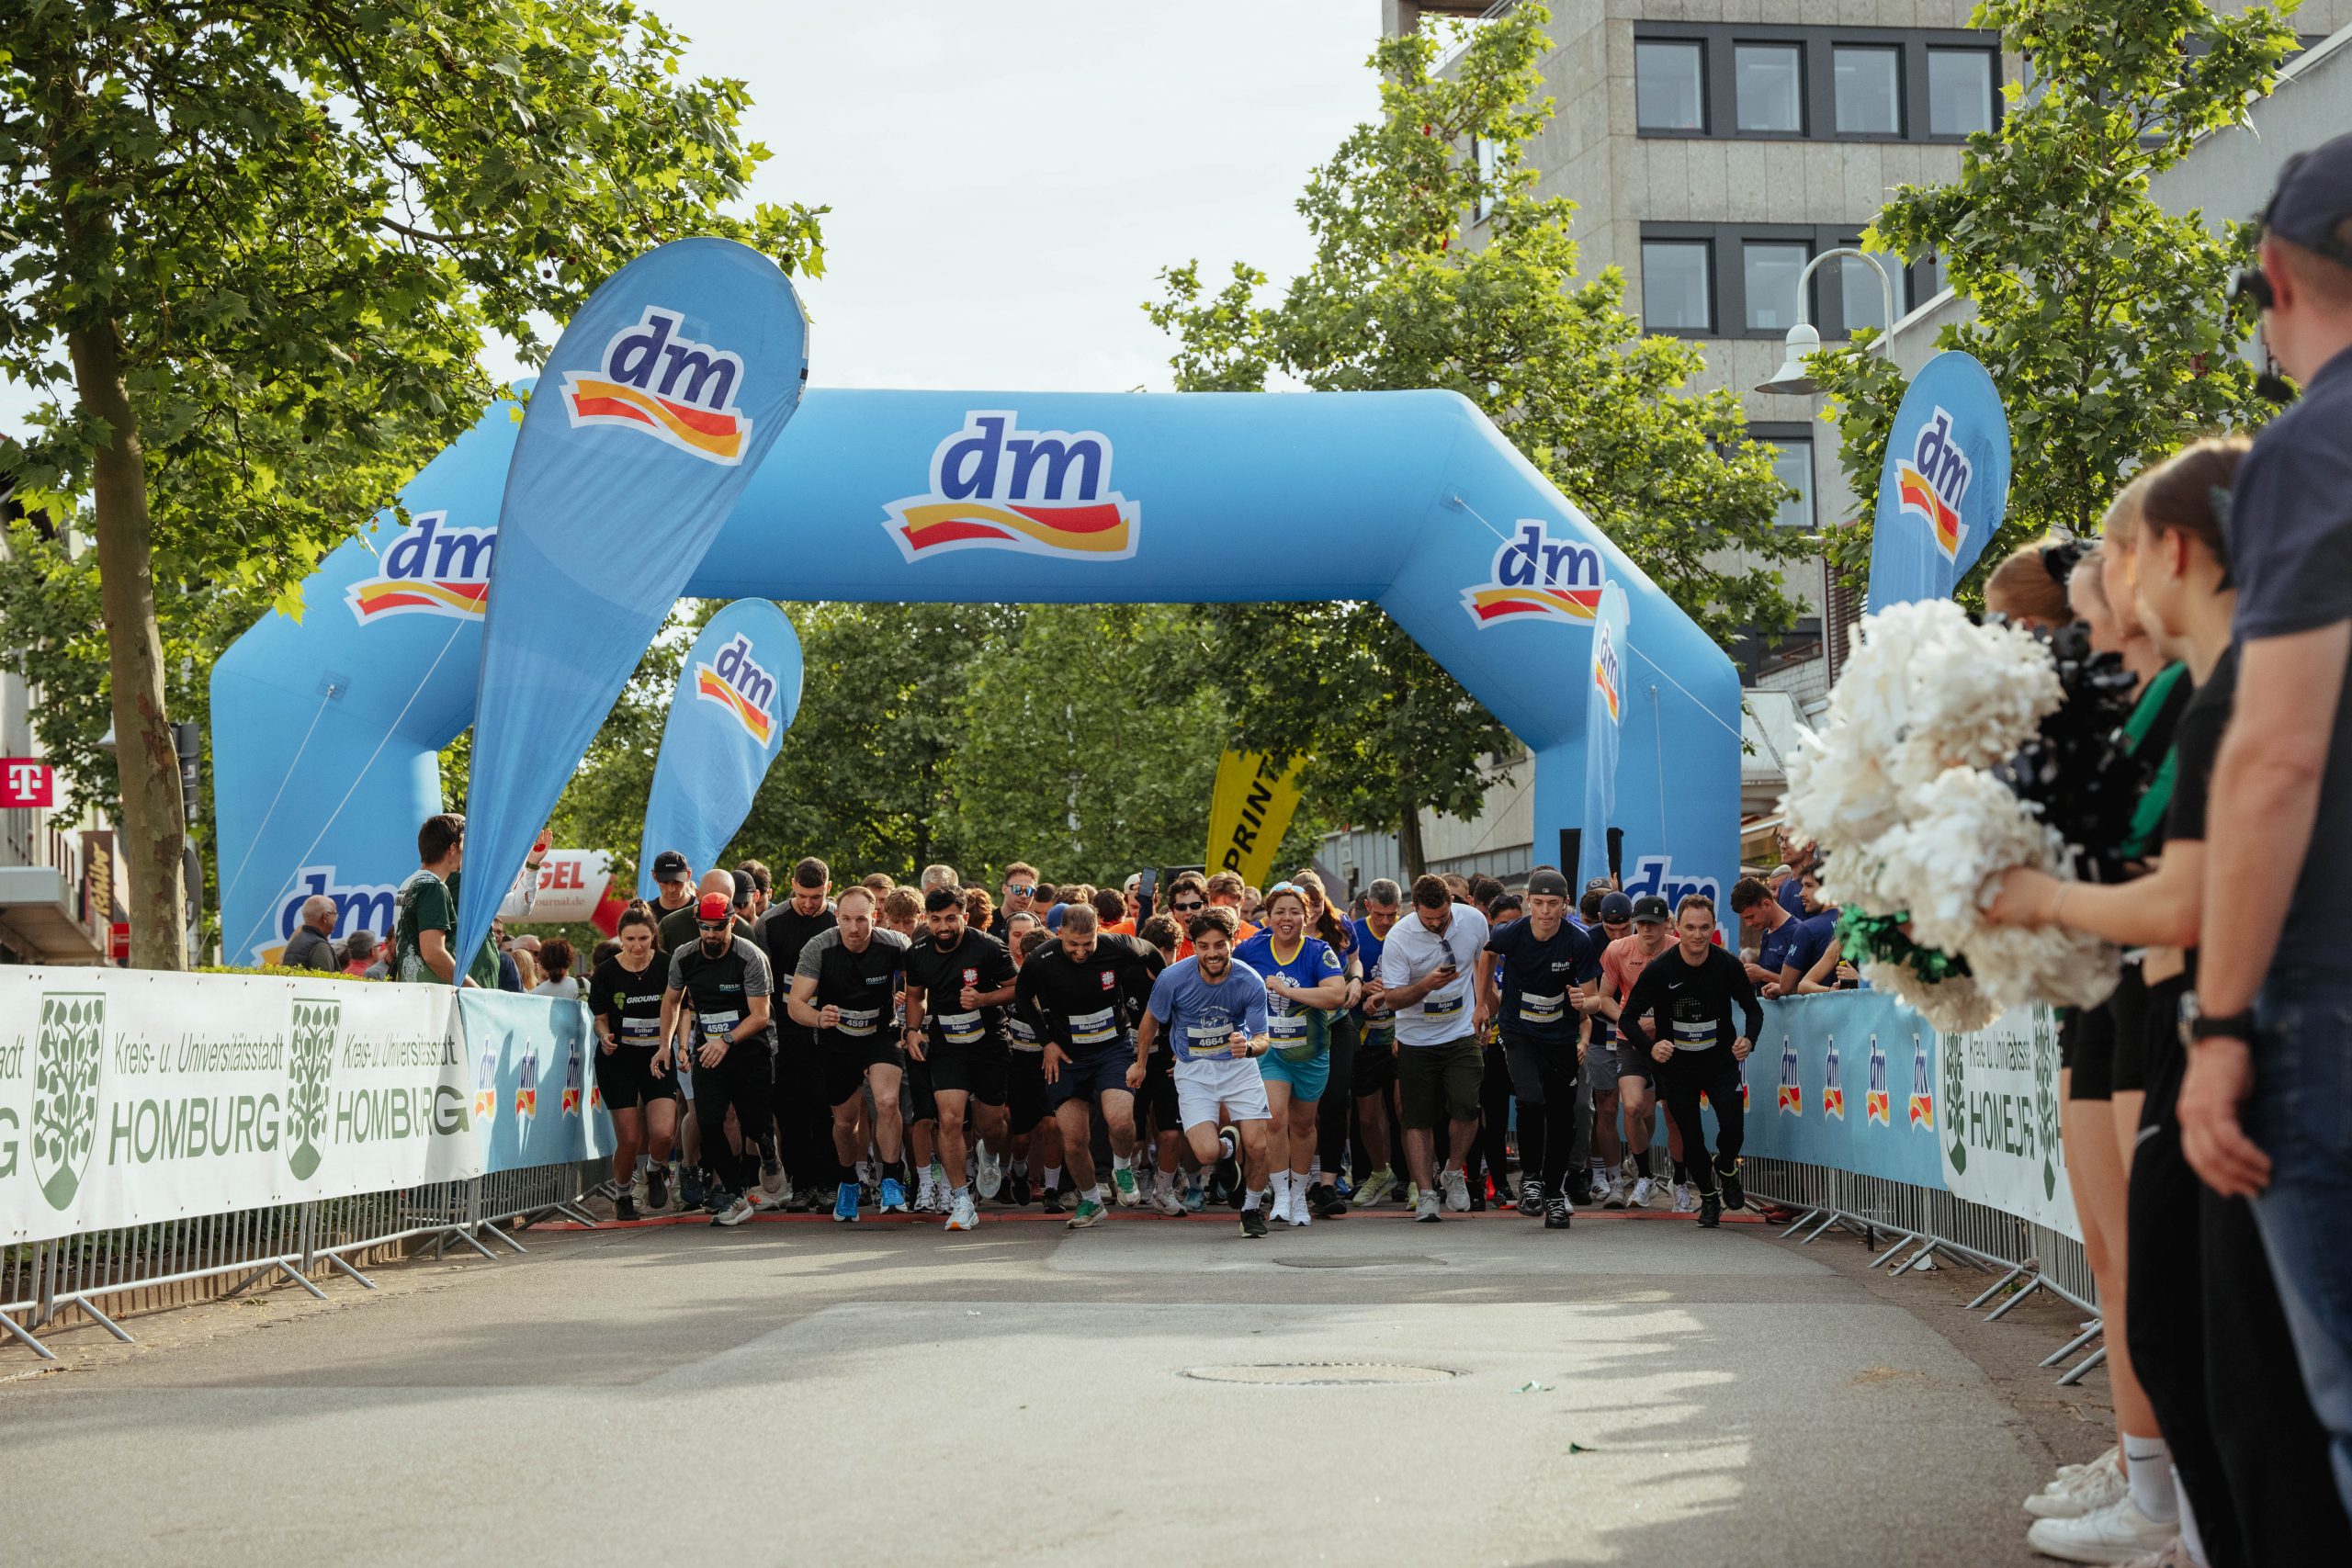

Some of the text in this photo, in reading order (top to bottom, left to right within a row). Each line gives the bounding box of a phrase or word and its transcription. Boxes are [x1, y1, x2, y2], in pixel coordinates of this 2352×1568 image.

[608, 314, 737, 412] dm
[940, 417, 1102, 501] dm
[1917, 414, 1968, 513] dm
[386, 517, 498, 580] dm
[1498, 525, 1600, 587] dm
[717, 638, 774, 709] dm
[1600, 627, 1618, 690] dm
[9, 764, 42, 801] T
[514, 862, 585, 890] GEL
[707, 1022, 729, 1033] 4592
[846, 1019, 869, 1028] 4591
[1199, 1036, 1224, 1047] 4664
[114, 1032, 285, 1075] Kreis- u. Universitätsstadt
[520, 1040, 536, 1089] dm
[565, 1043, 580, 1089] dm
[1781, 1040, 1798, 1086] dm
[1826, 1039, 1838, 1088] dm
[1869, 1039, 1886, 1091] dm
[1914, 1038, 1929, 1094] dm
[107, 1092, 280, 1167] HOMBURG
[335, 1085, 470, 1145] HOMBURG
